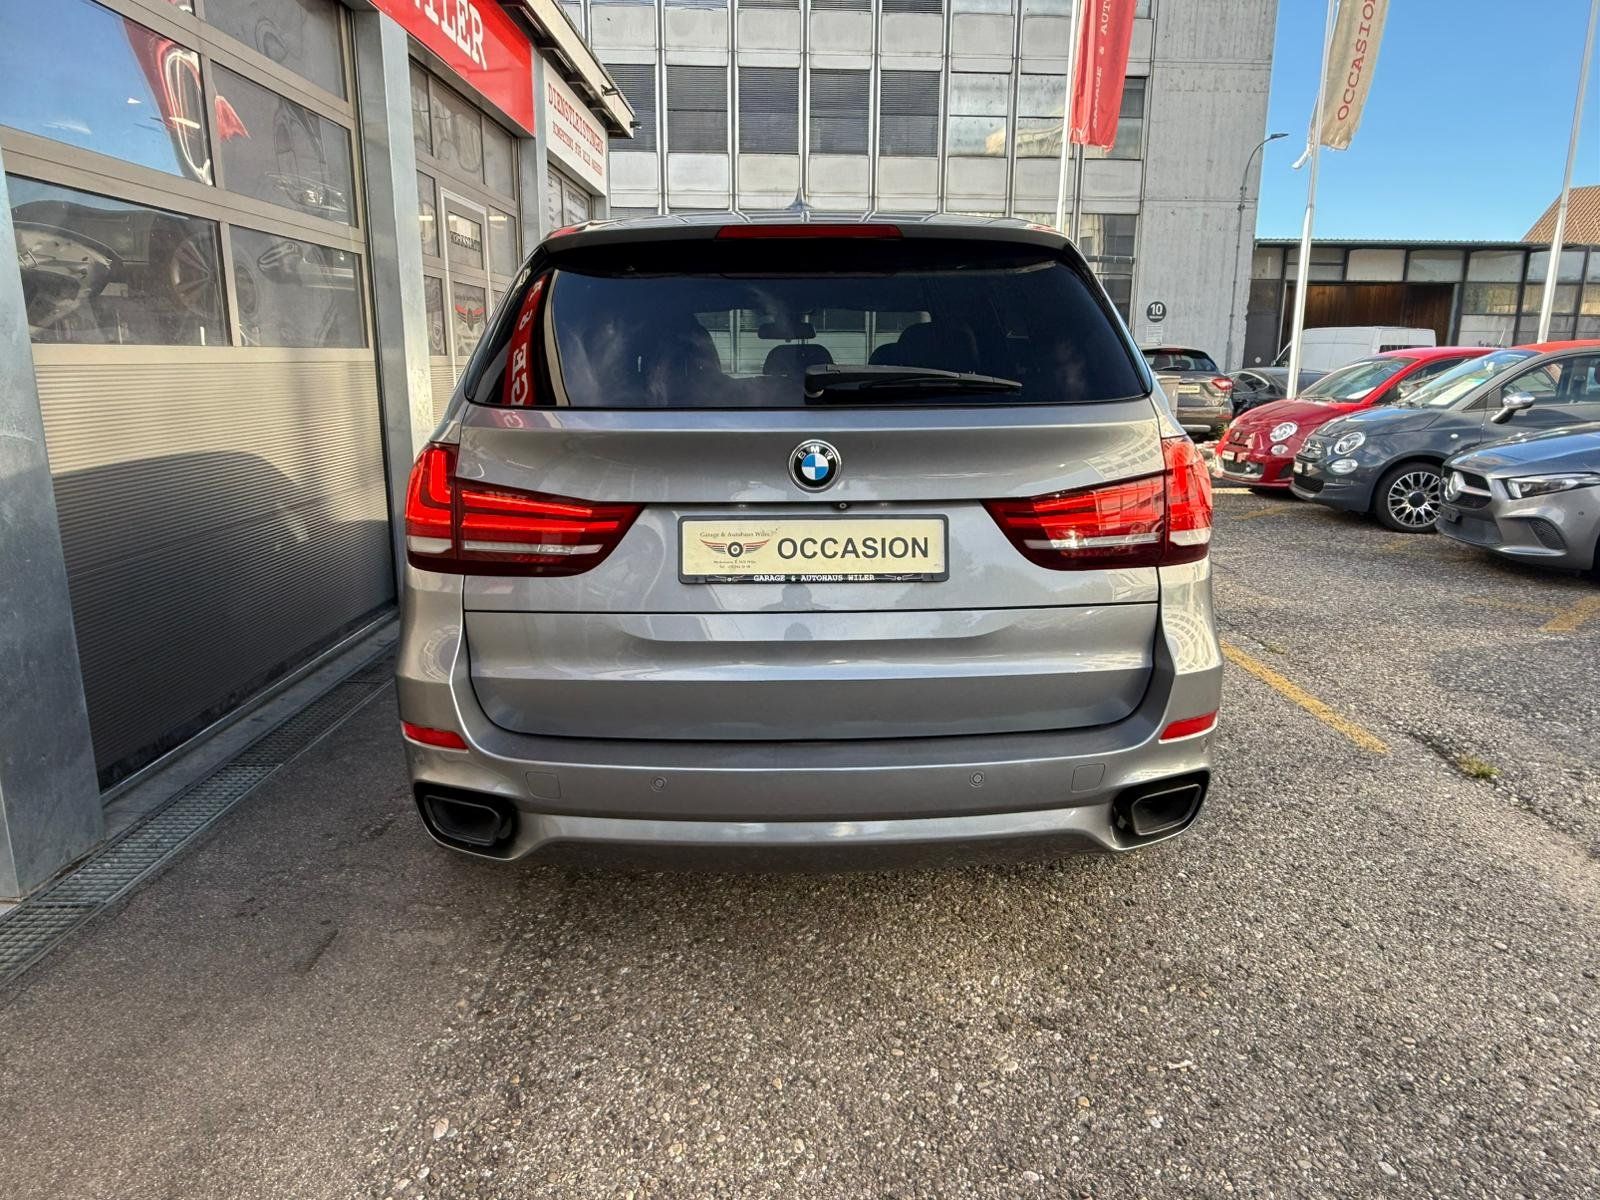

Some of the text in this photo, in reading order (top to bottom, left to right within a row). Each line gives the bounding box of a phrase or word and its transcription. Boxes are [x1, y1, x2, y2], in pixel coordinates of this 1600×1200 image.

[1100, 0, 1111, 36] AUT
[1337, 0, 1376, 121] OCCASIO
[1150, 303, 1164, 315] 10
[797, 445, 834, 461] BMW
[777, 536, 928, 559] OCCASION
[753, 574, 786, 582] GARAGE
[790, 574, 796, 582] &
